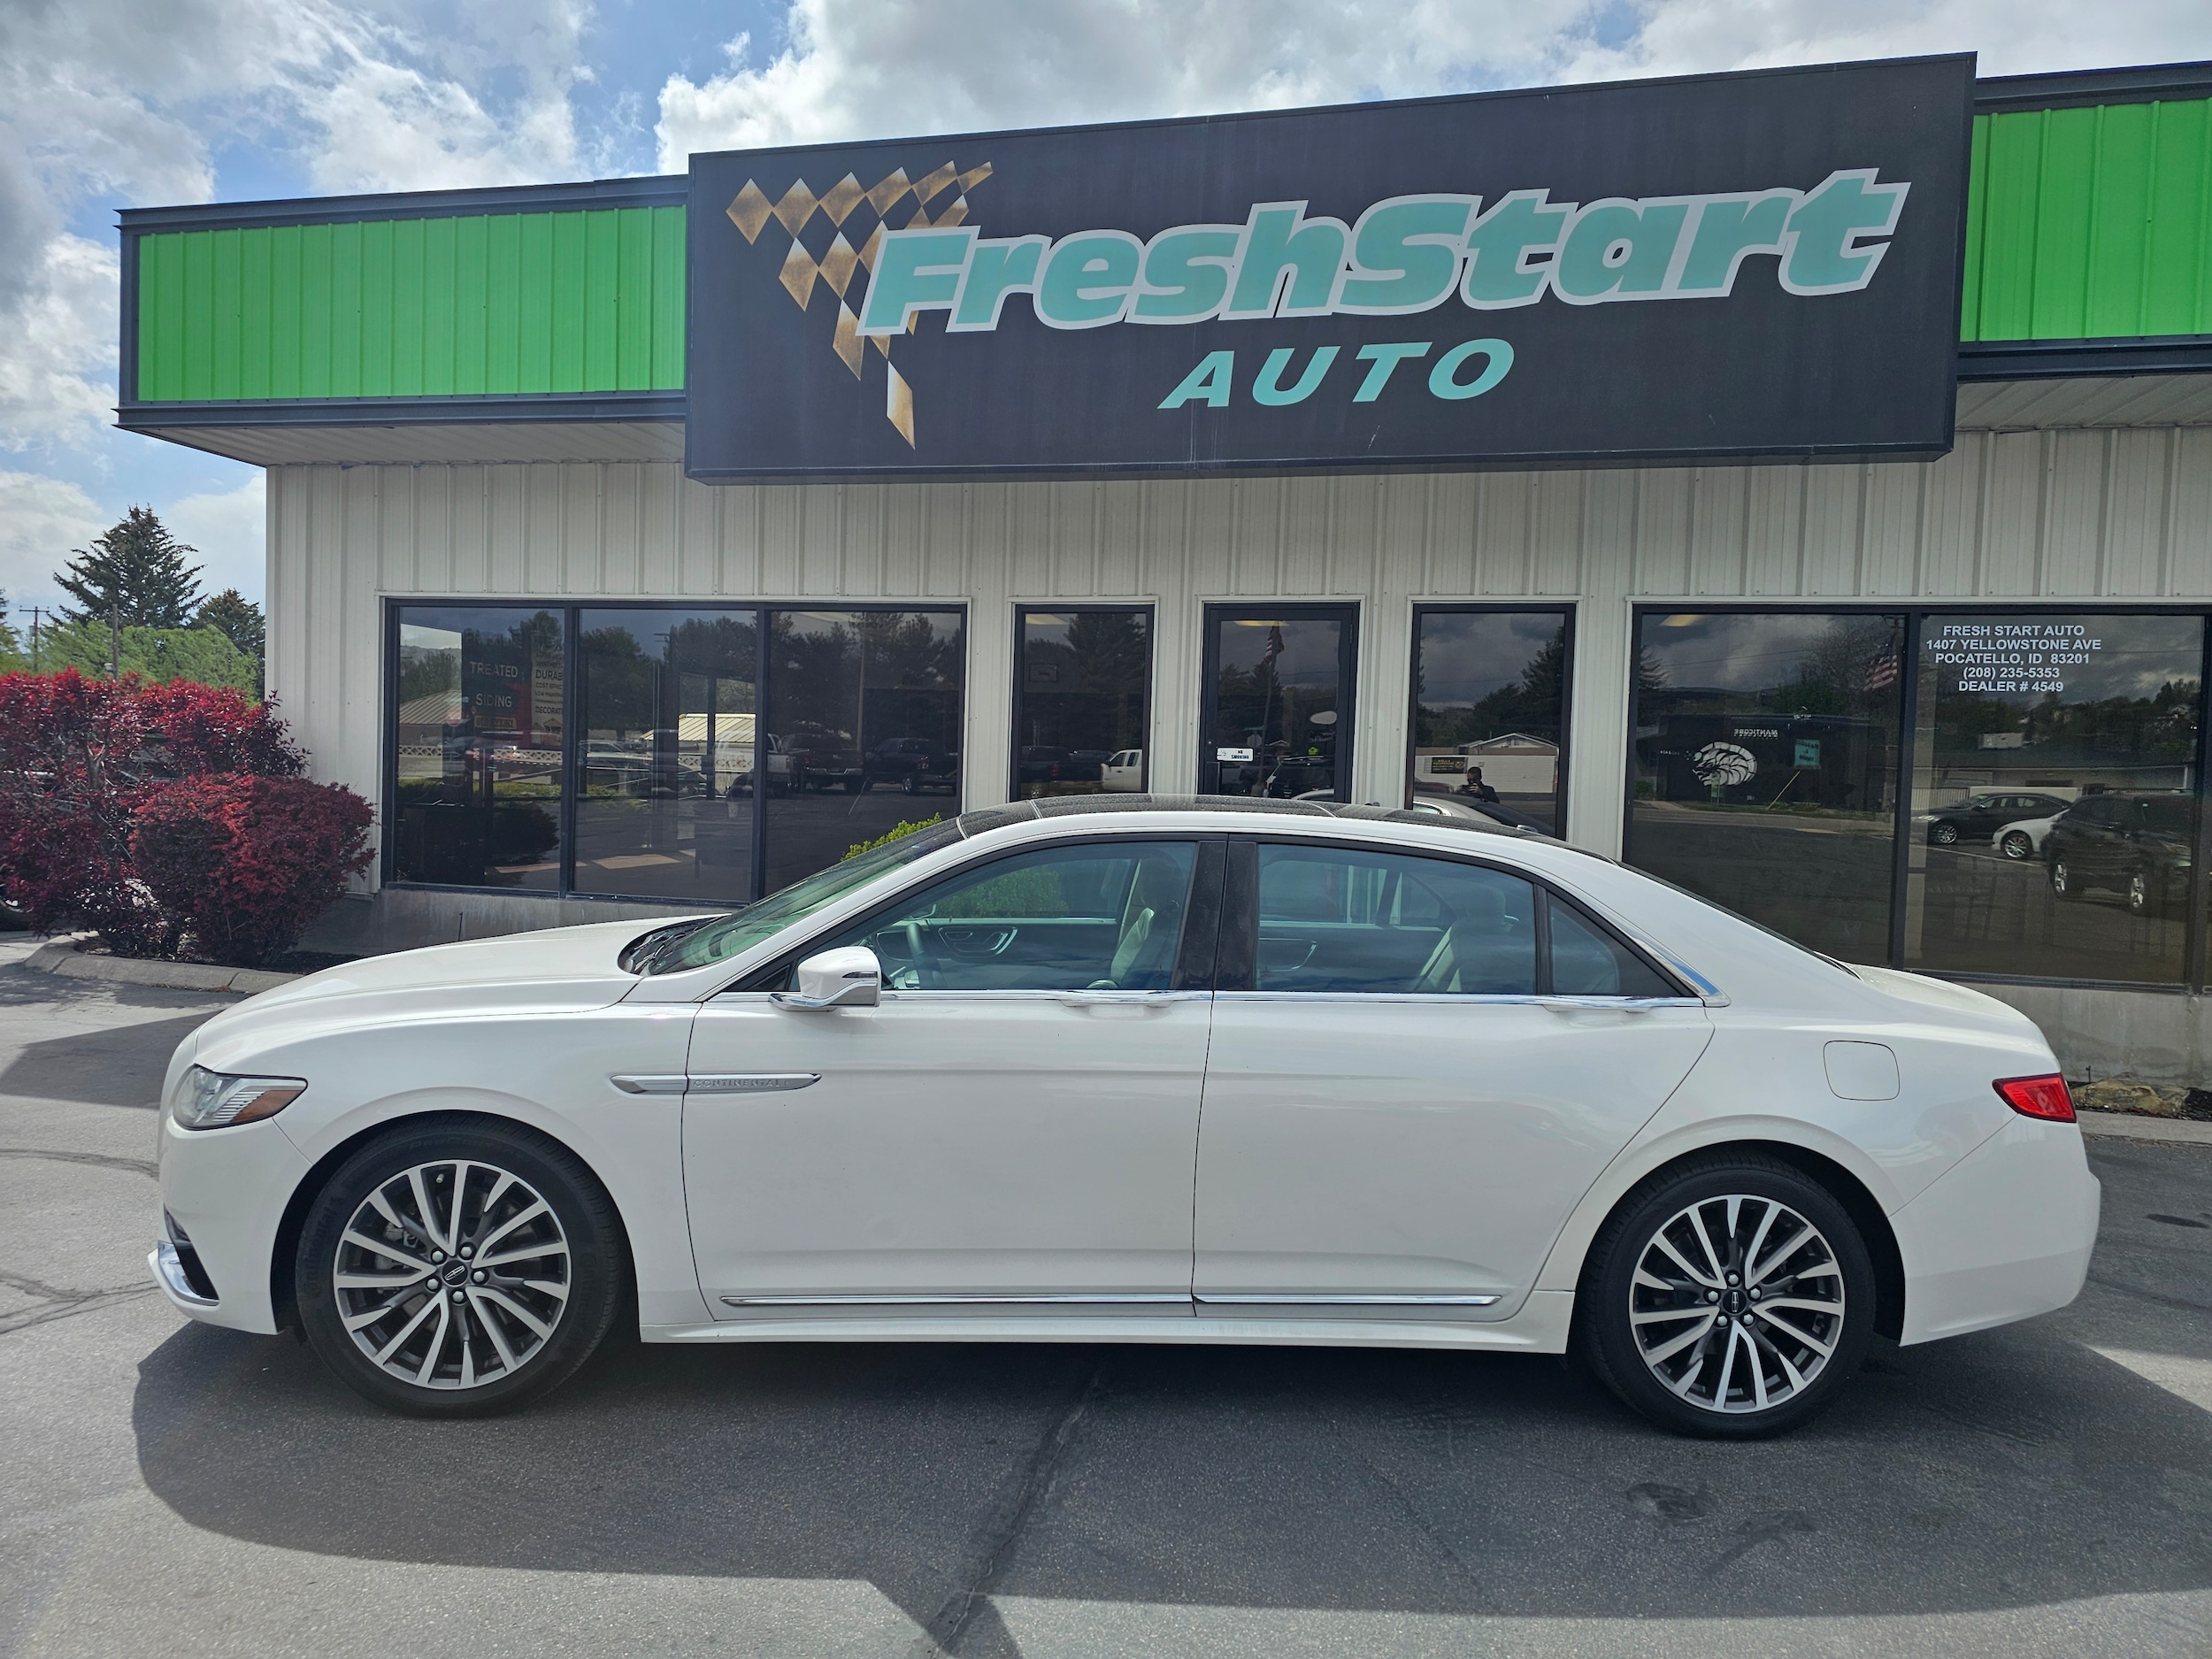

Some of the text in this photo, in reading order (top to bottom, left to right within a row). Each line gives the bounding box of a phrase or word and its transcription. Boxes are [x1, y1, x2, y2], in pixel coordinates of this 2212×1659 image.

[856, 167, 1911, 336] FreshStart
[1157, 338, 1515, 410] AUTO
[1943, 625, 2085, 636] FRESH START AUTO
[1926, 639, 2101, 650] 1407 YELLOWSTONE AVE
[1935, 653, 2089, 665] POCATELLO, ID 83201
[469, 661, 518, 678] TREATED
[1962, 666, 2060, 680] (208) 235-5353
[1958, 680, 2063, 692] DEALER # 4549
[475, 693, 512, 708] SIDING
[693, 1079, 780, 1088] CONTINENTAL
